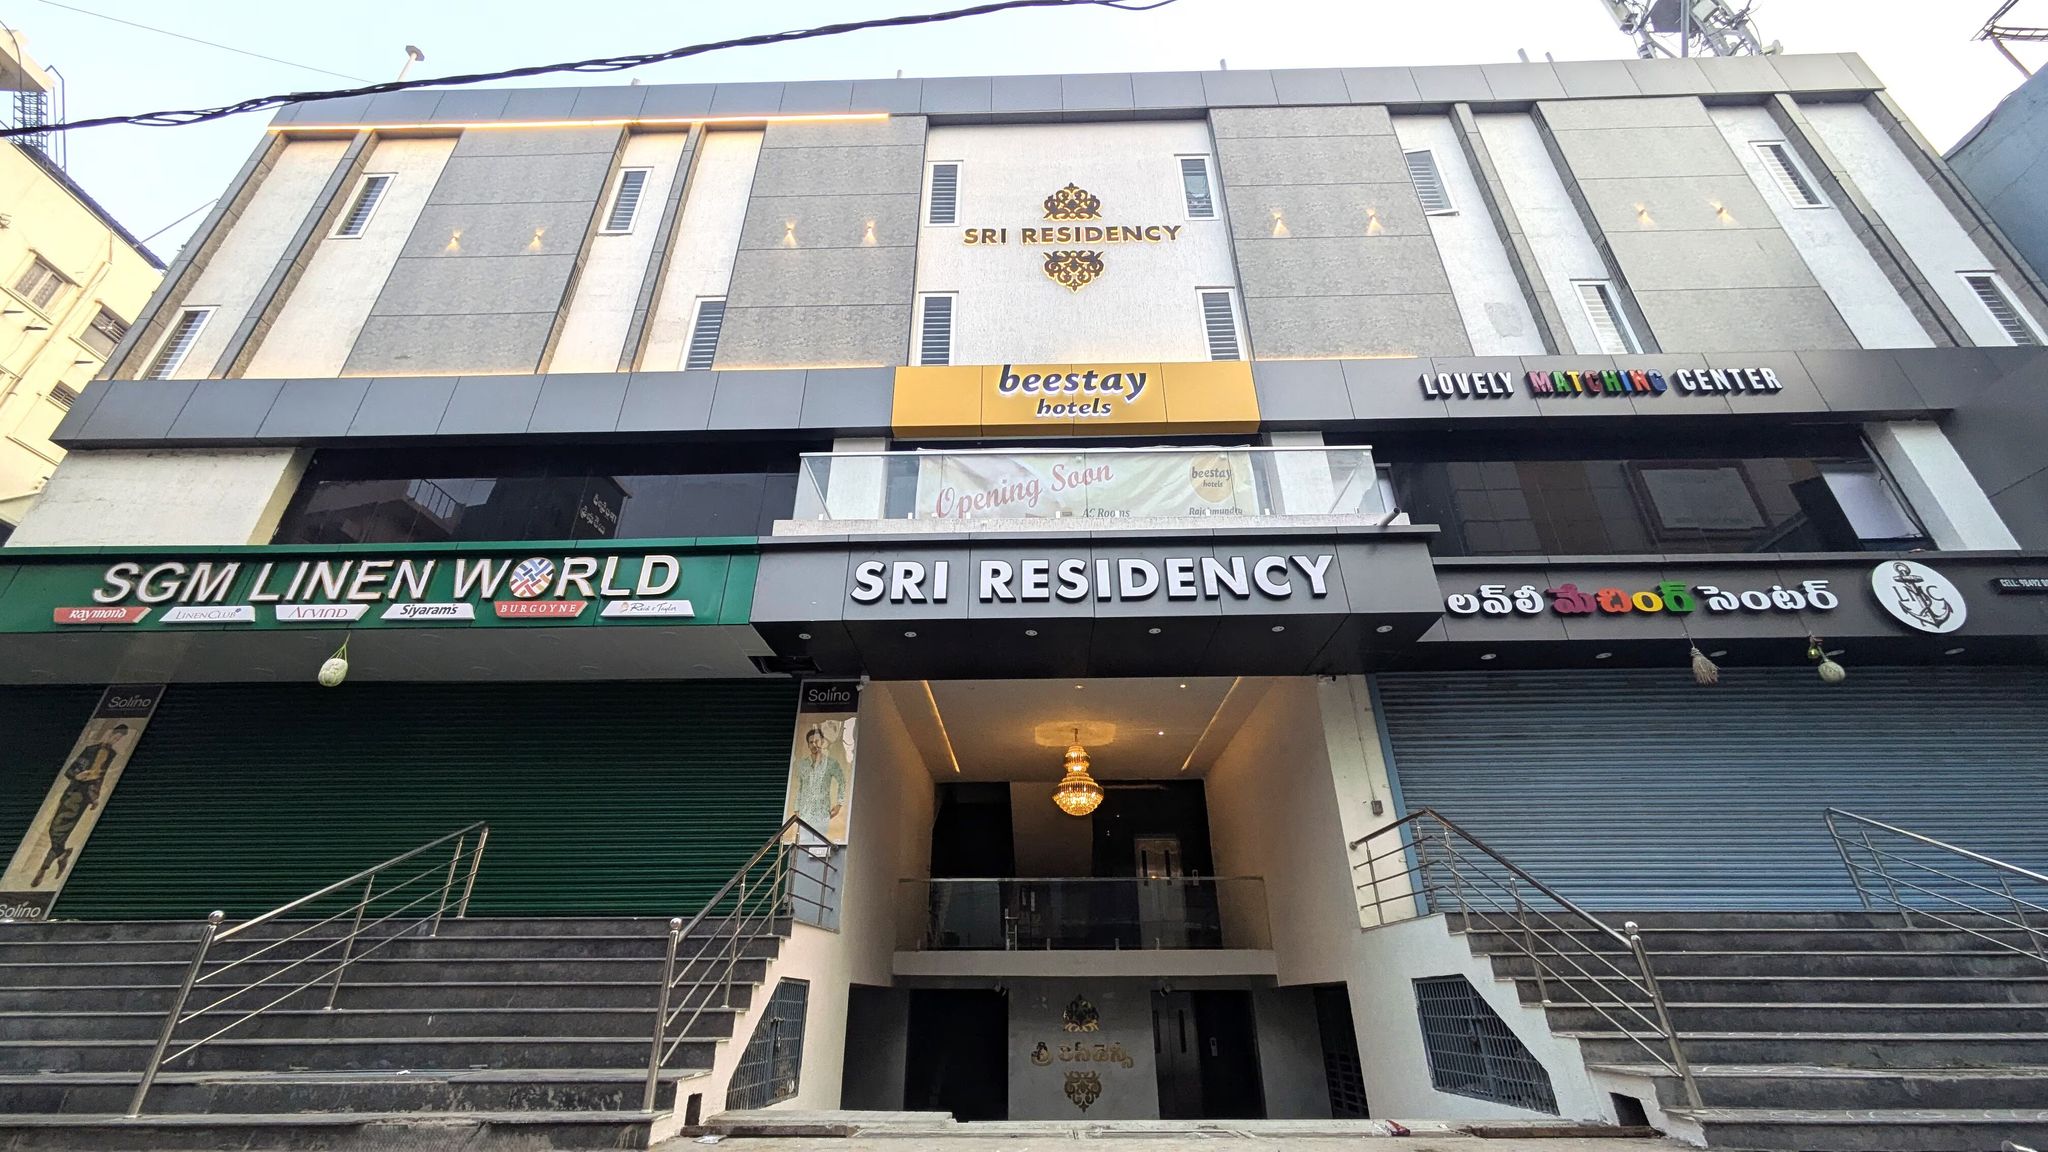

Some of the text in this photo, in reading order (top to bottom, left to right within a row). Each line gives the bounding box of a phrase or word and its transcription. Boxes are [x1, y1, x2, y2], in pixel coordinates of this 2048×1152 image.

[963, 225, 1181, 244] SRI RESIDENCY
[999, 364, 1147, 401] beestay
[1420, 367, 1783, 398] LOVELY MATCHING CENTER
[1036, 398, 1112, 416] hotels
[1191, 466, 1232, 481] beestay
[936, 463, 1113, 518] Opening Soon
[1202, 480, 1223, 488] hotels
[92, 554, 681, 603] SGM LINEN WORLD
[850, 555, 1334, 602] SRI RESIDENCY
[69, 608, 126, 622] Raymond
[500, 604, 576, 614] BURGOYNE
[108, 695, 151, 708] Solino
[808, 687, 850, 702] Solino
